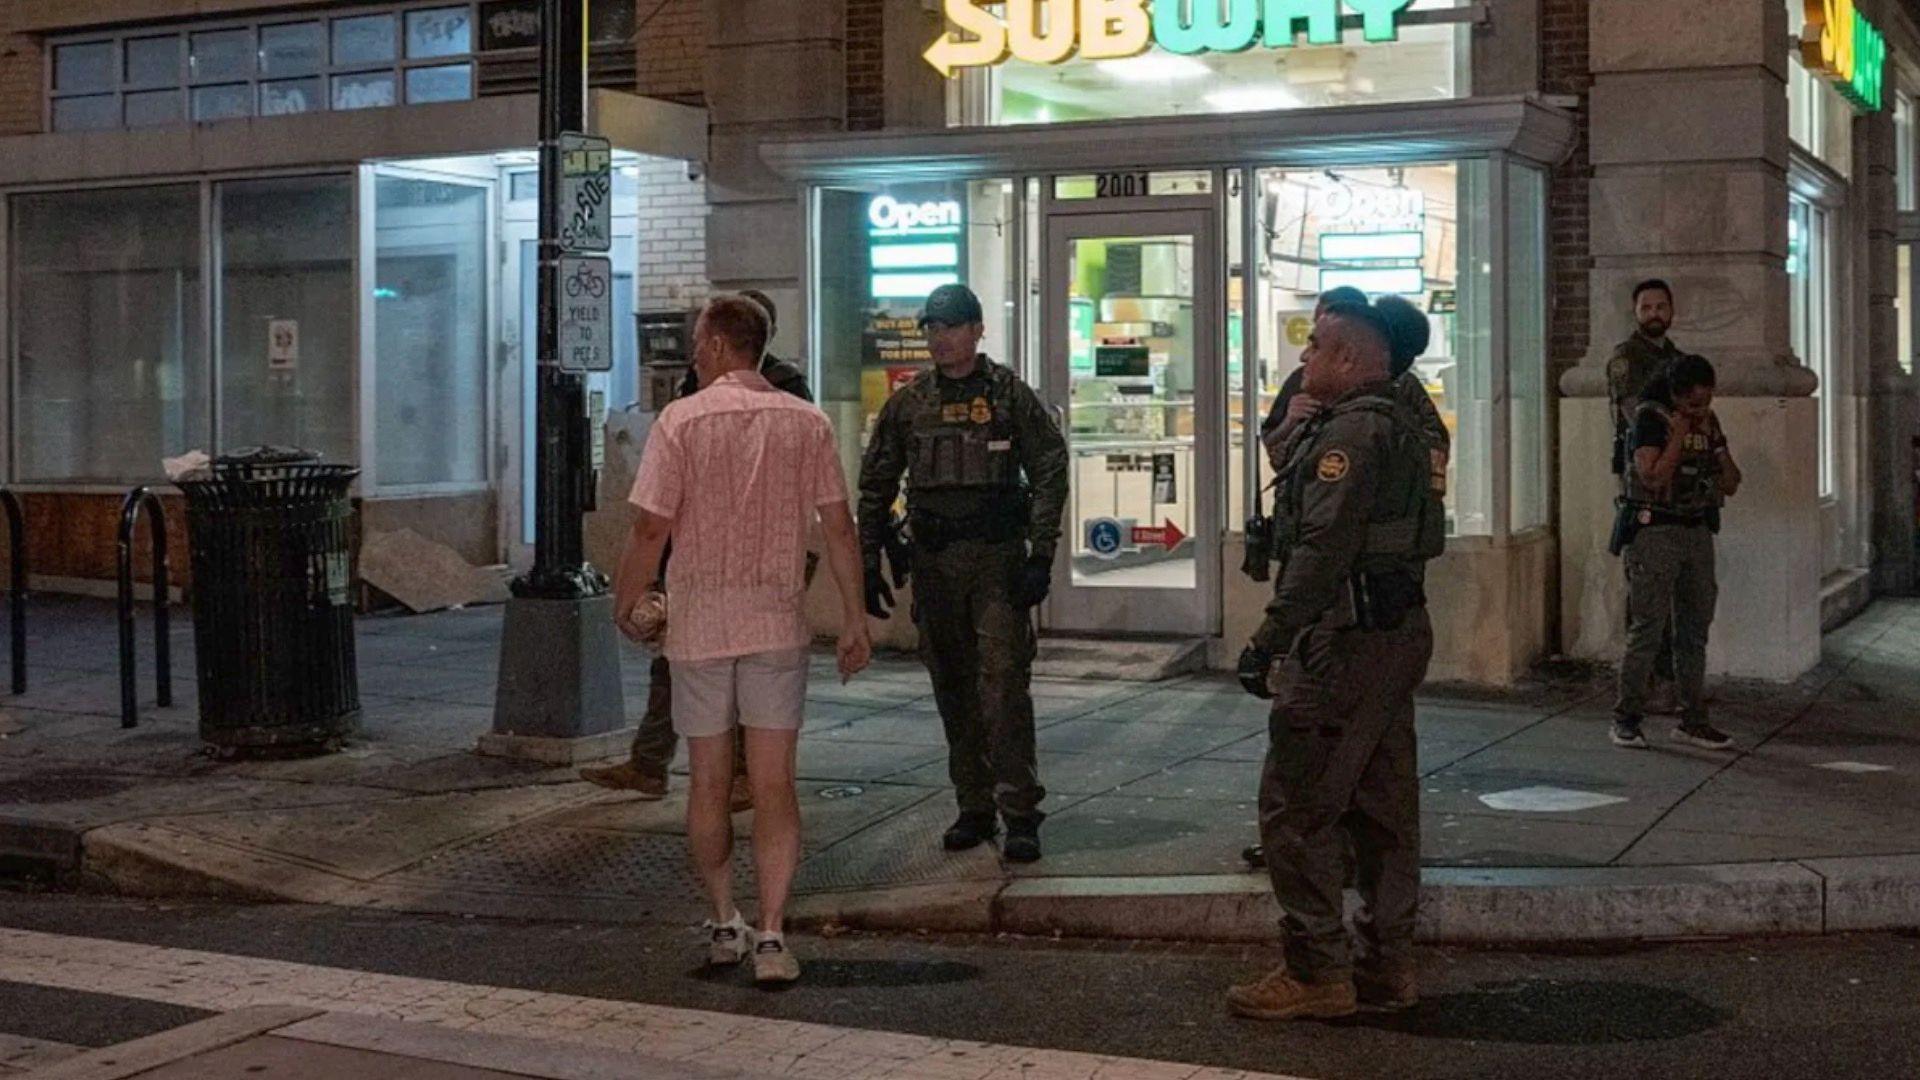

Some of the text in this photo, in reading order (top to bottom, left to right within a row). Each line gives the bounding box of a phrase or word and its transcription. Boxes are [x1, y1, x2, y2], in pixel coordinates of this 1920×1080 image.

[1096, 173, 1148, 198] 2001
[868, 195, 961, 235] Open
[569, 306, 601, 321] YIELD
[580, 327, 593, 340] TO
[1685, 433, 1709, 450] FBI
